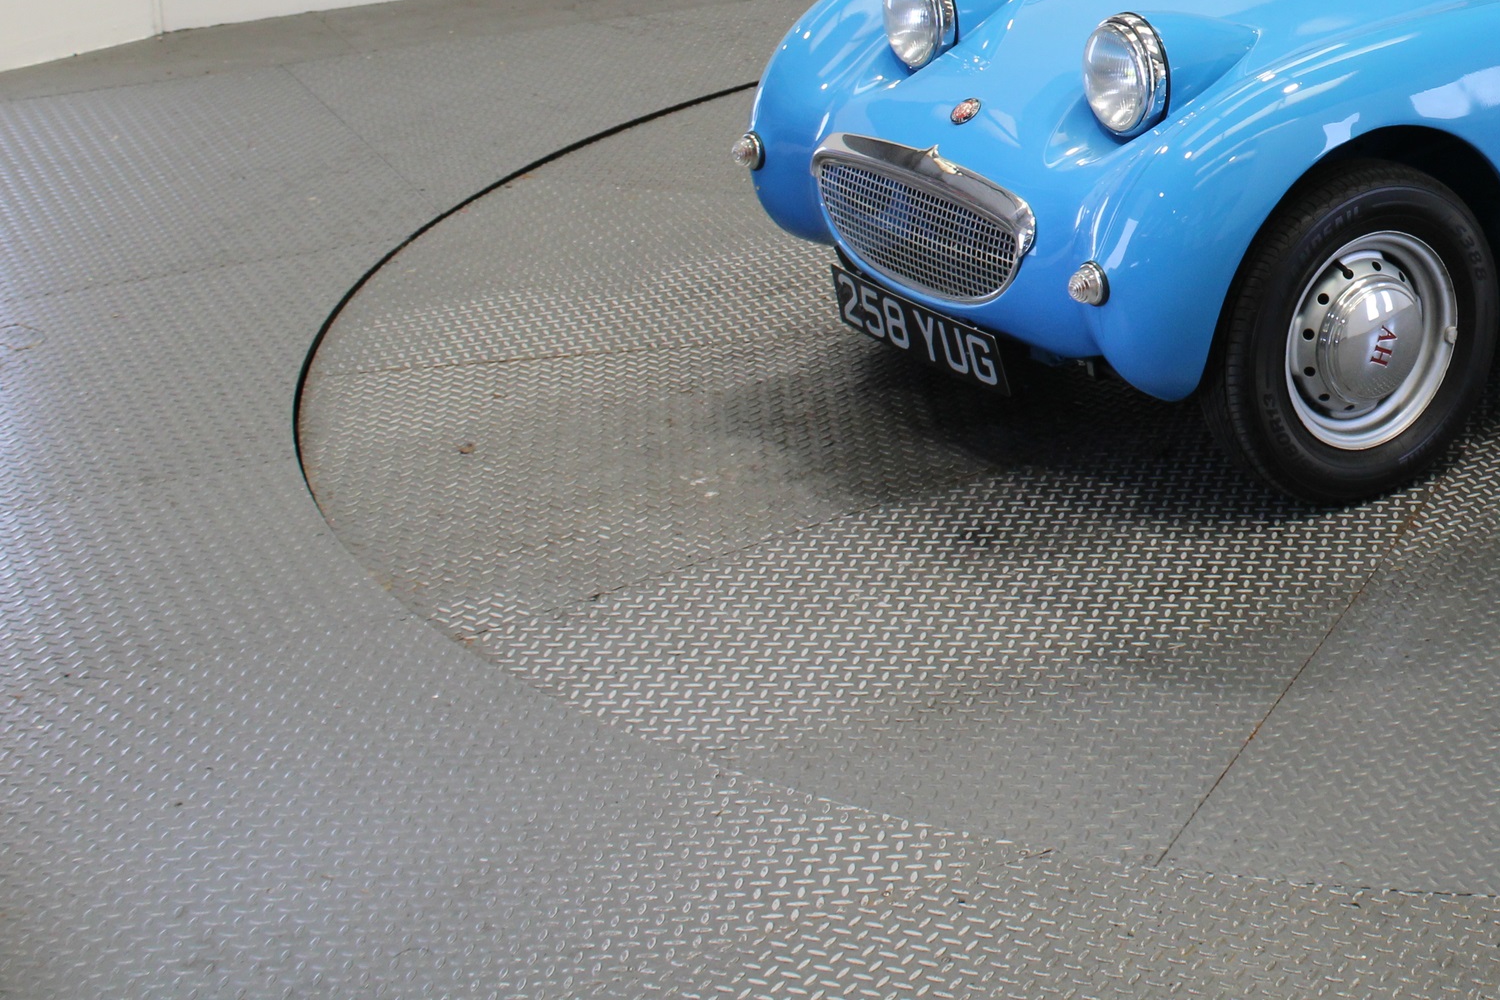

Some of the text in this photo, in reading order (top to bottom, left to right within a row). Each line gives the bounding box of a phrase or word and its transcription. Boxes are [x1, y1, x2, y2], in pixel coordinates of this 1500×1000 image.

[838, 273, 998, 386] 258 YUG
[1370, 324, 1398, 368] AH
